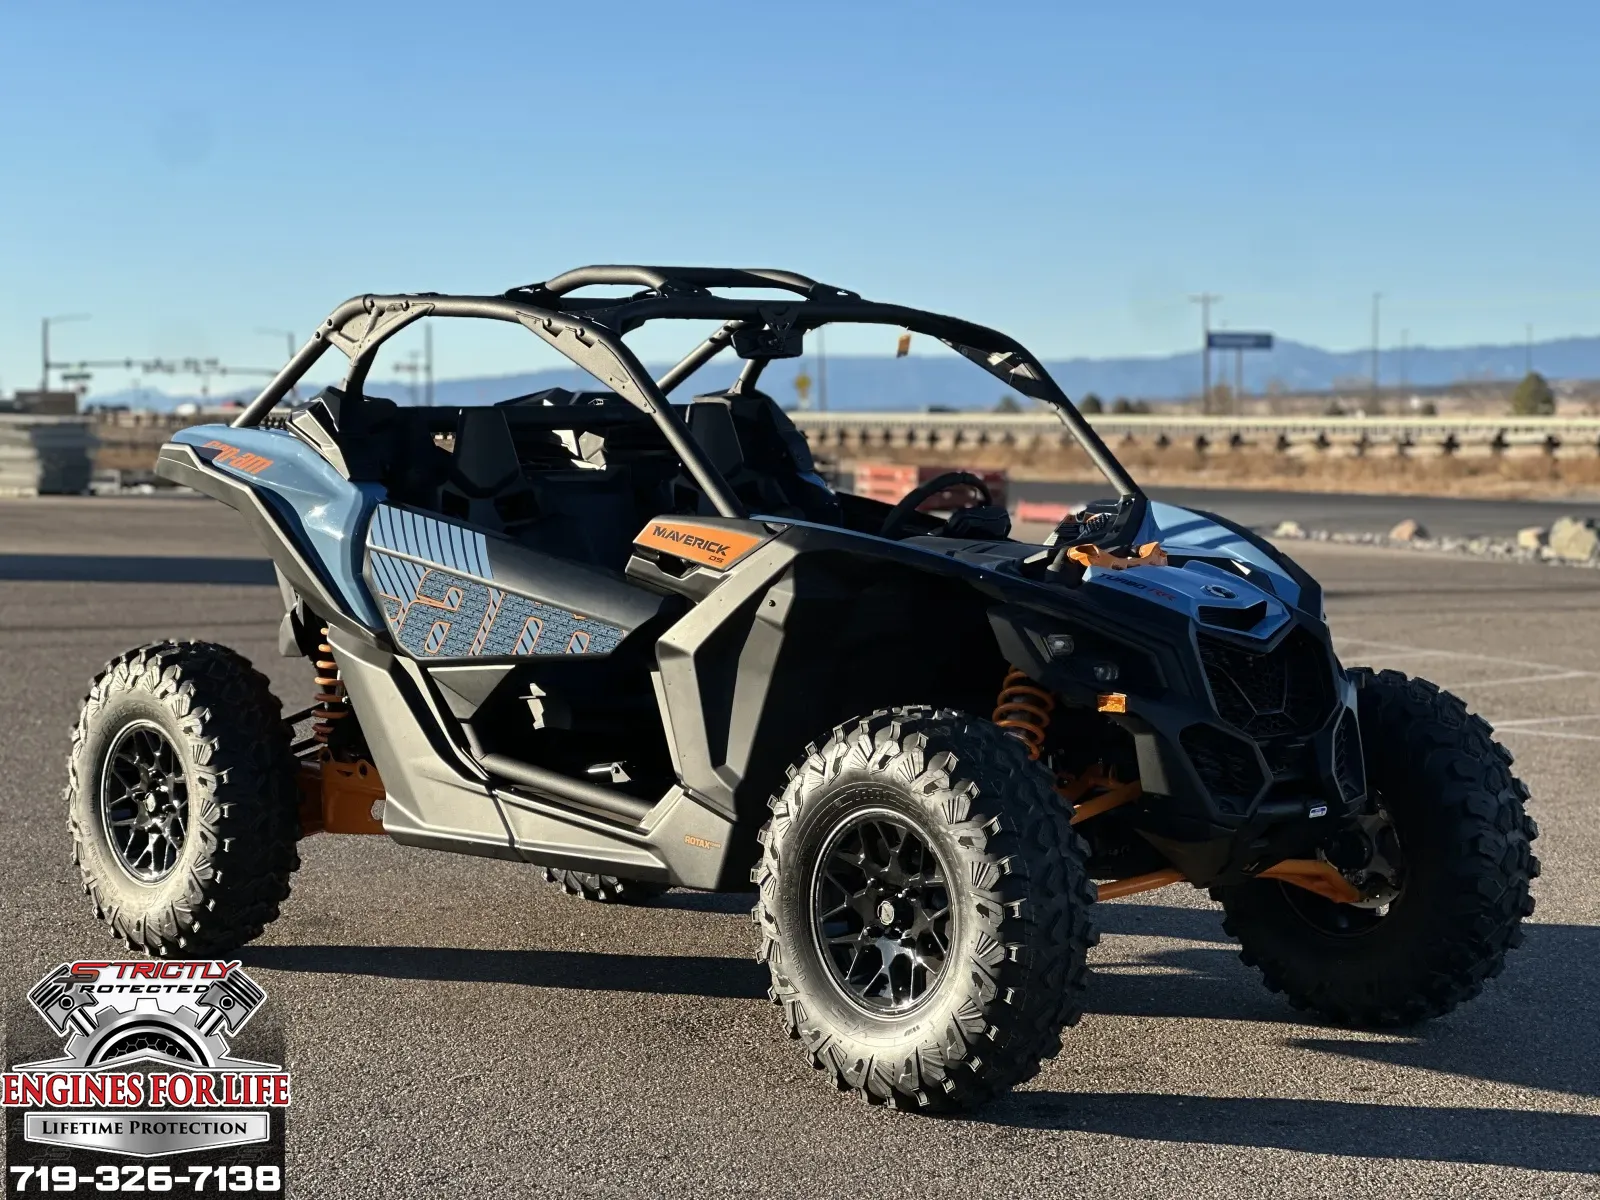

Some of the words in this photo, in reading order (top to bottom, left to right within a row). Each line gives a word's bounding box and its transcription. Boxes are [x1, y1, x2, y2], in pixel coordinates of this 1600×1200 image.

[653, 526, 731, 556] MAVERICK
[1099, 573, 1147, 589] TURBO
[684, 835, 710, 850] ROTAX
